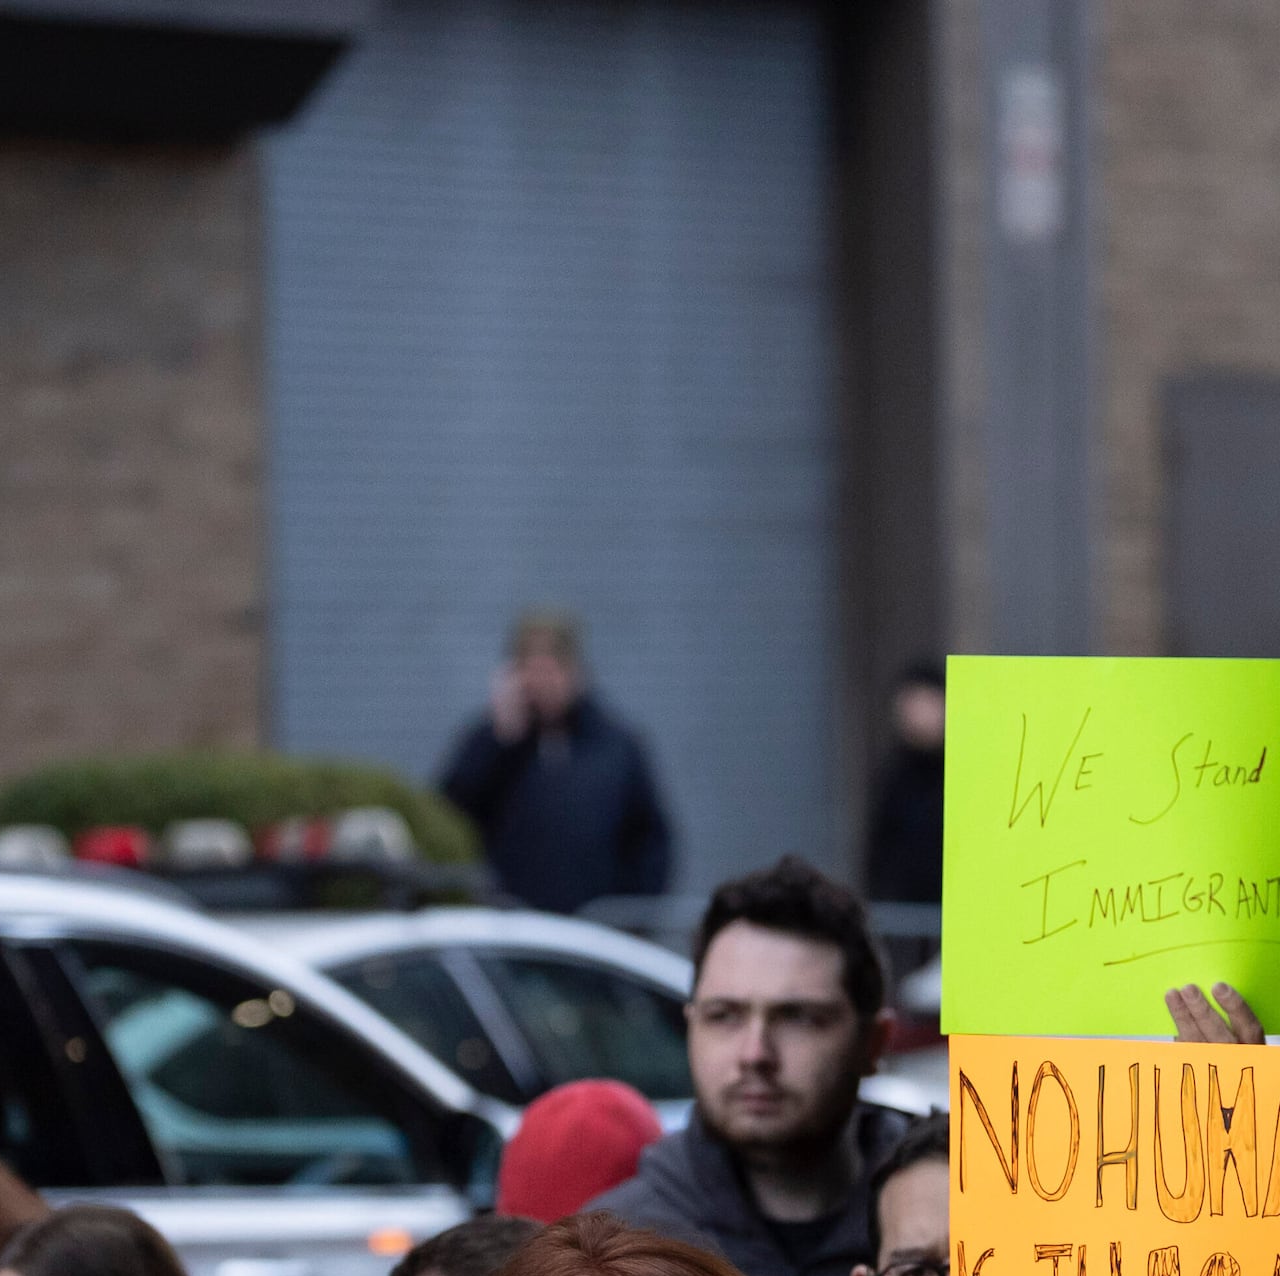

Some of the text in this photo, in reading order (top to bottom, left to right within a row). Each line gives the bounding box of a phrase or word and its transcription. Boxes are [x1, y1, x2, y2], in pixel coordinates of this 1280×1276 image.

[1008, 707, 1104, 829] WE
[1129, 732, 1267, 825] Stand
[958, 1060, 1080, 1202] NO
